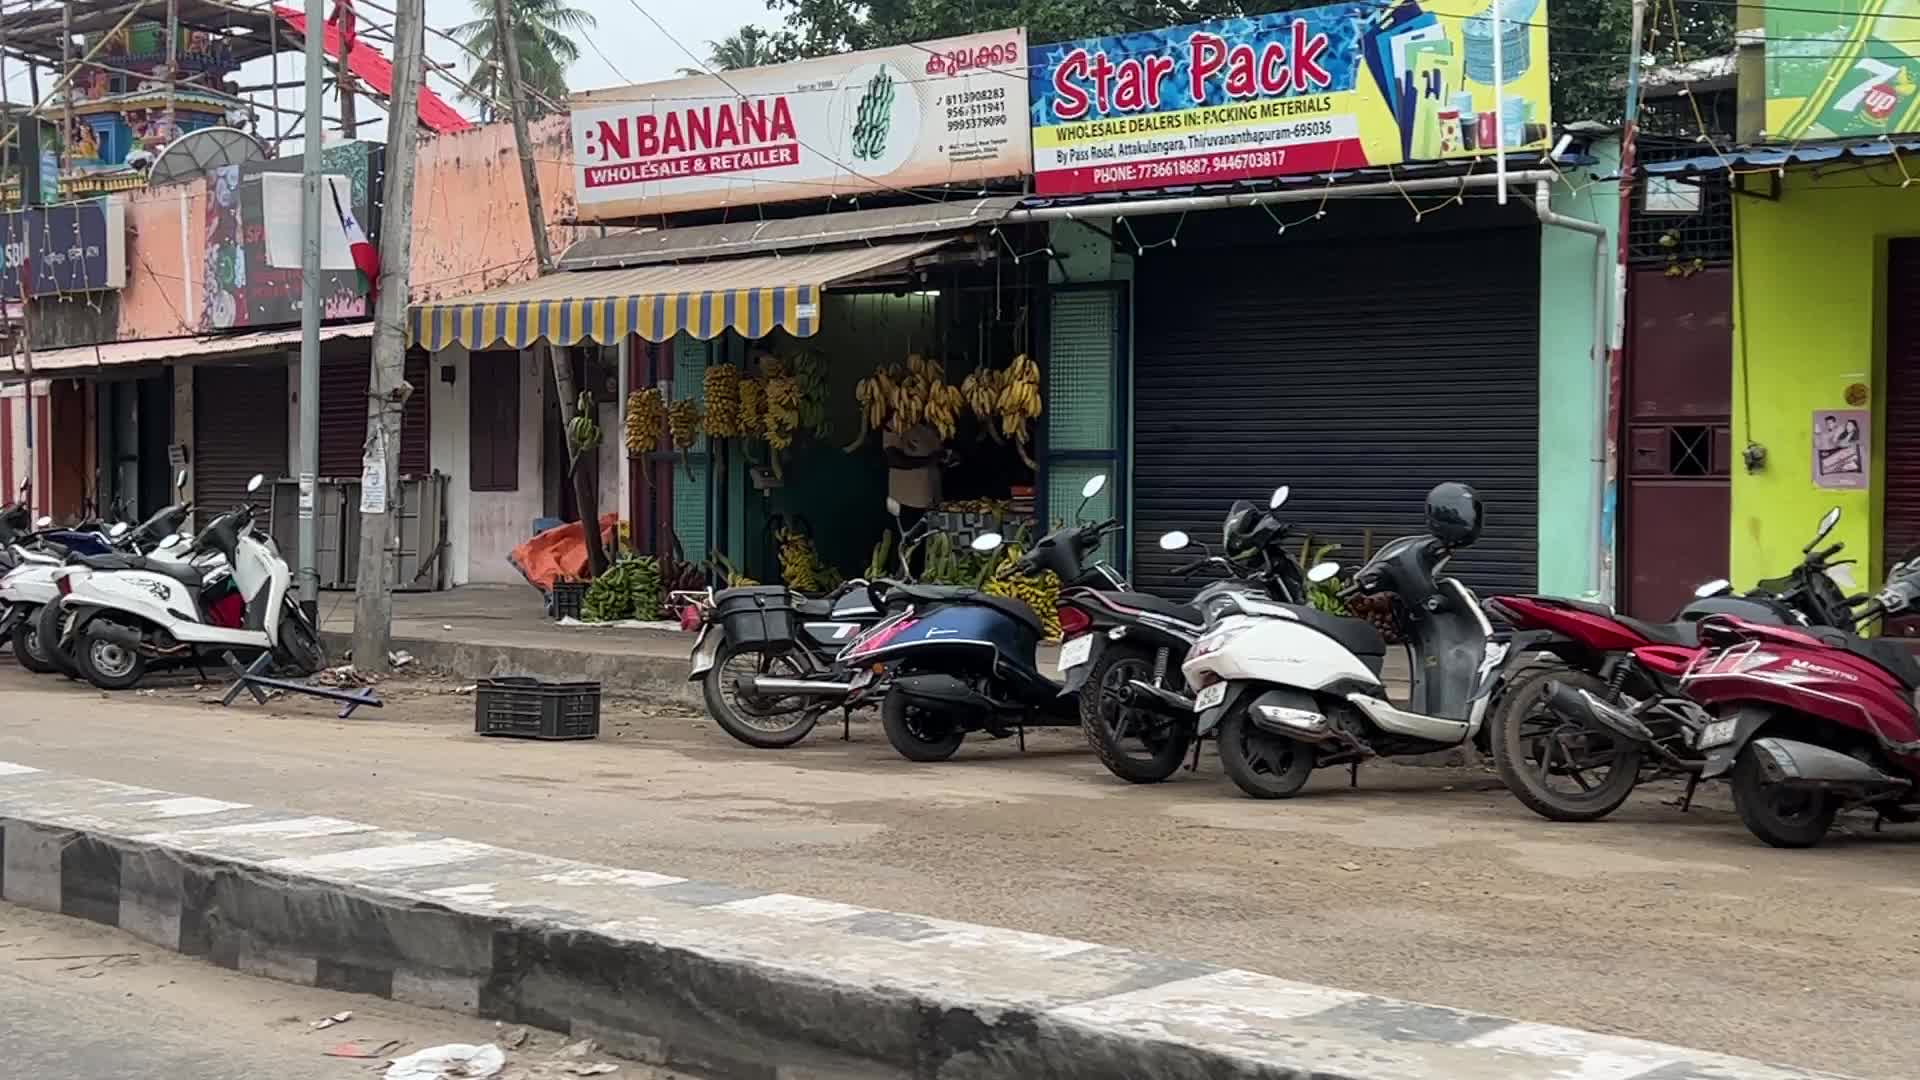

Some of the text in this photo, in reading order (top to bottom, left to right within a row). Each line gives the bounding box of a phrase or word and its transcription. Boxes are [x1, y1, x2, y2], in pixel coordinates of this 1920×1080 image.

[1053, 18, 1331, 119] Star Pack
[636, 96, 797, 156] BANANA
[1056, 123, 1126, 141] WHOLESALE
[1129, 114, 1181, 132] DEALERS
[1203, 105, 1257, 124] PACKING
[1260, 97, 1331, 118] METERIALS
[591, 149, 792, 184] WHOLESALE & RETAILER
[1056, 150, 1067, 165] By
[1069, 148, 1089, 162] Pass
[1091, 143, 1117, 159] Road,
[1212, 150, 1286, 172] 9446703817
